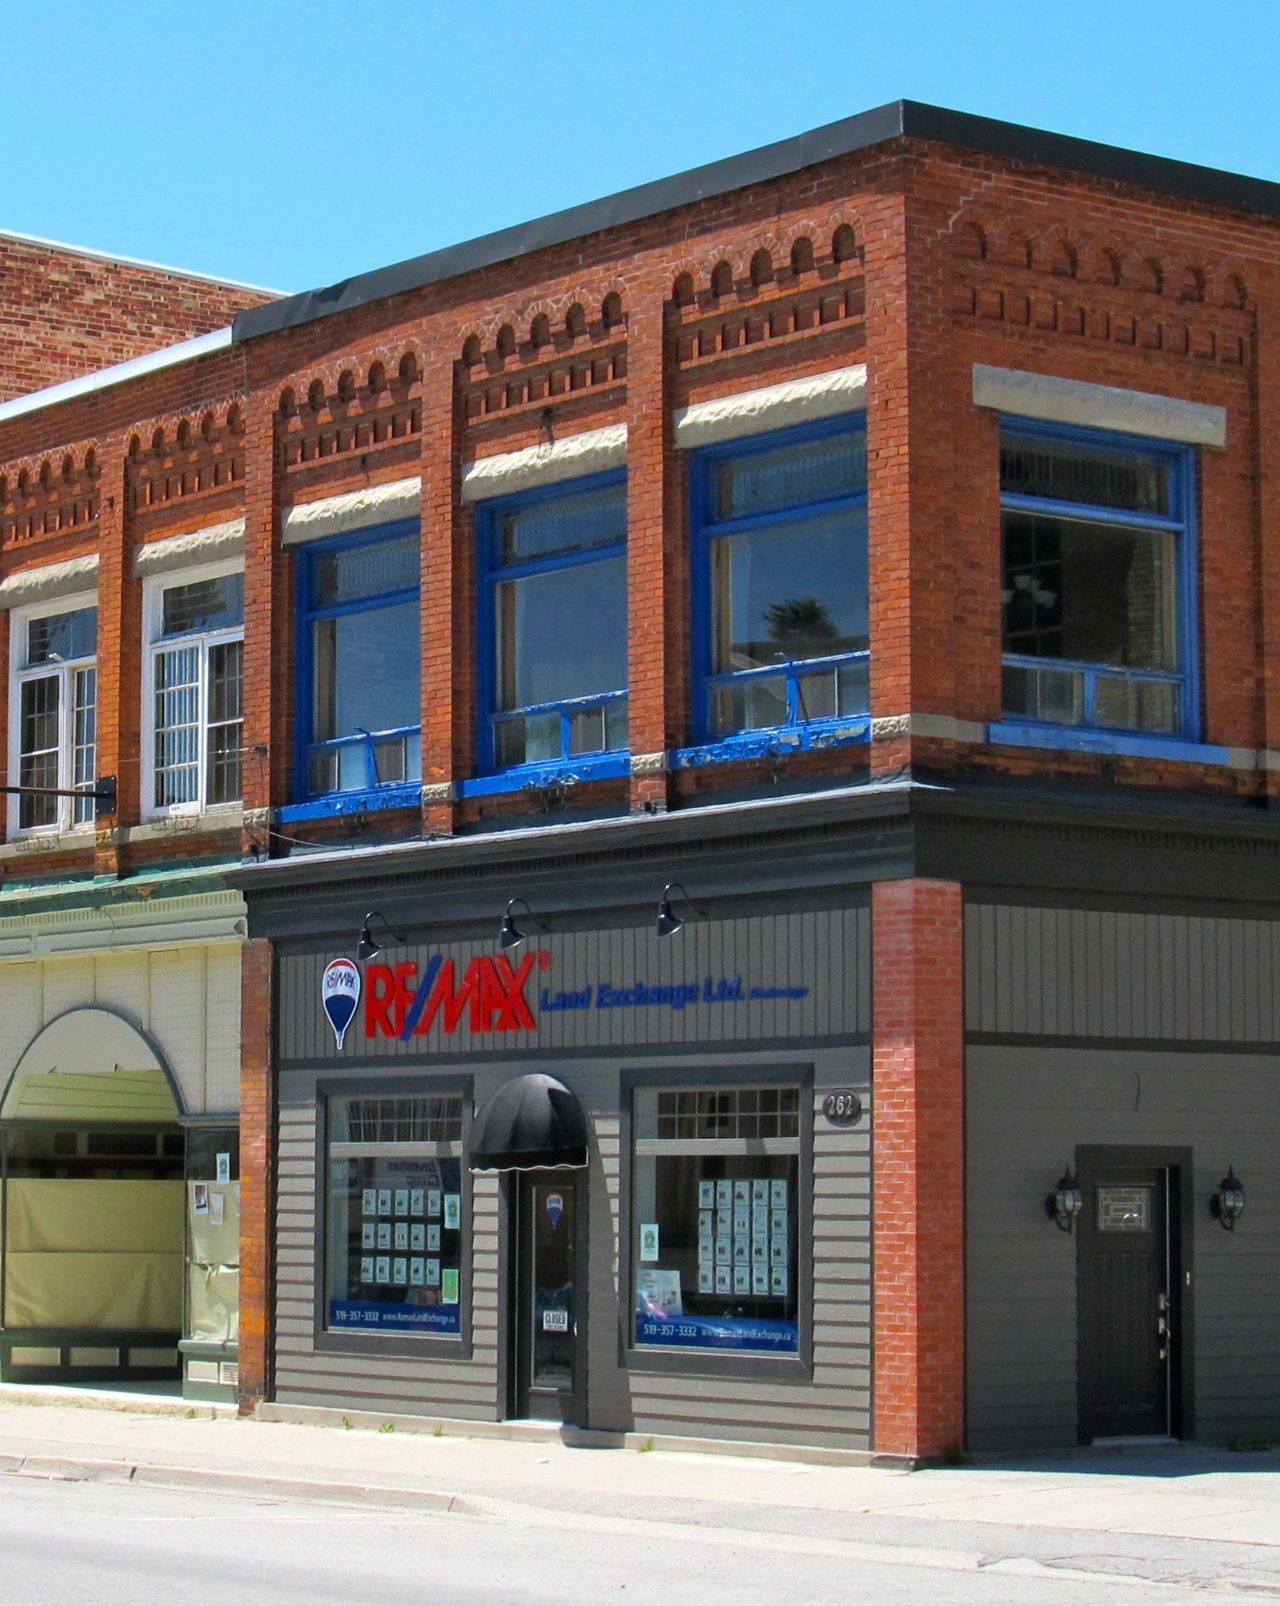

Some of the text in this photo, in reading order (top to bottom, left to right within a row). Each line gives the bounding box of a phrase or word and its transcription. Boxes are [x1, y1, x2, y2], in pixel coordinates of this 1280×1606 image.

[540, 987, 592, 1012] Land
[595, 982, 700, 1010] Exchange
[827, 1095, 853, 1116] 262
[335, 1310, 380, 1321] 519-357-3332
[545, 1311, 566, 1325] CLOSED
[643, 1323, 697, 1337] 519-357-3332
